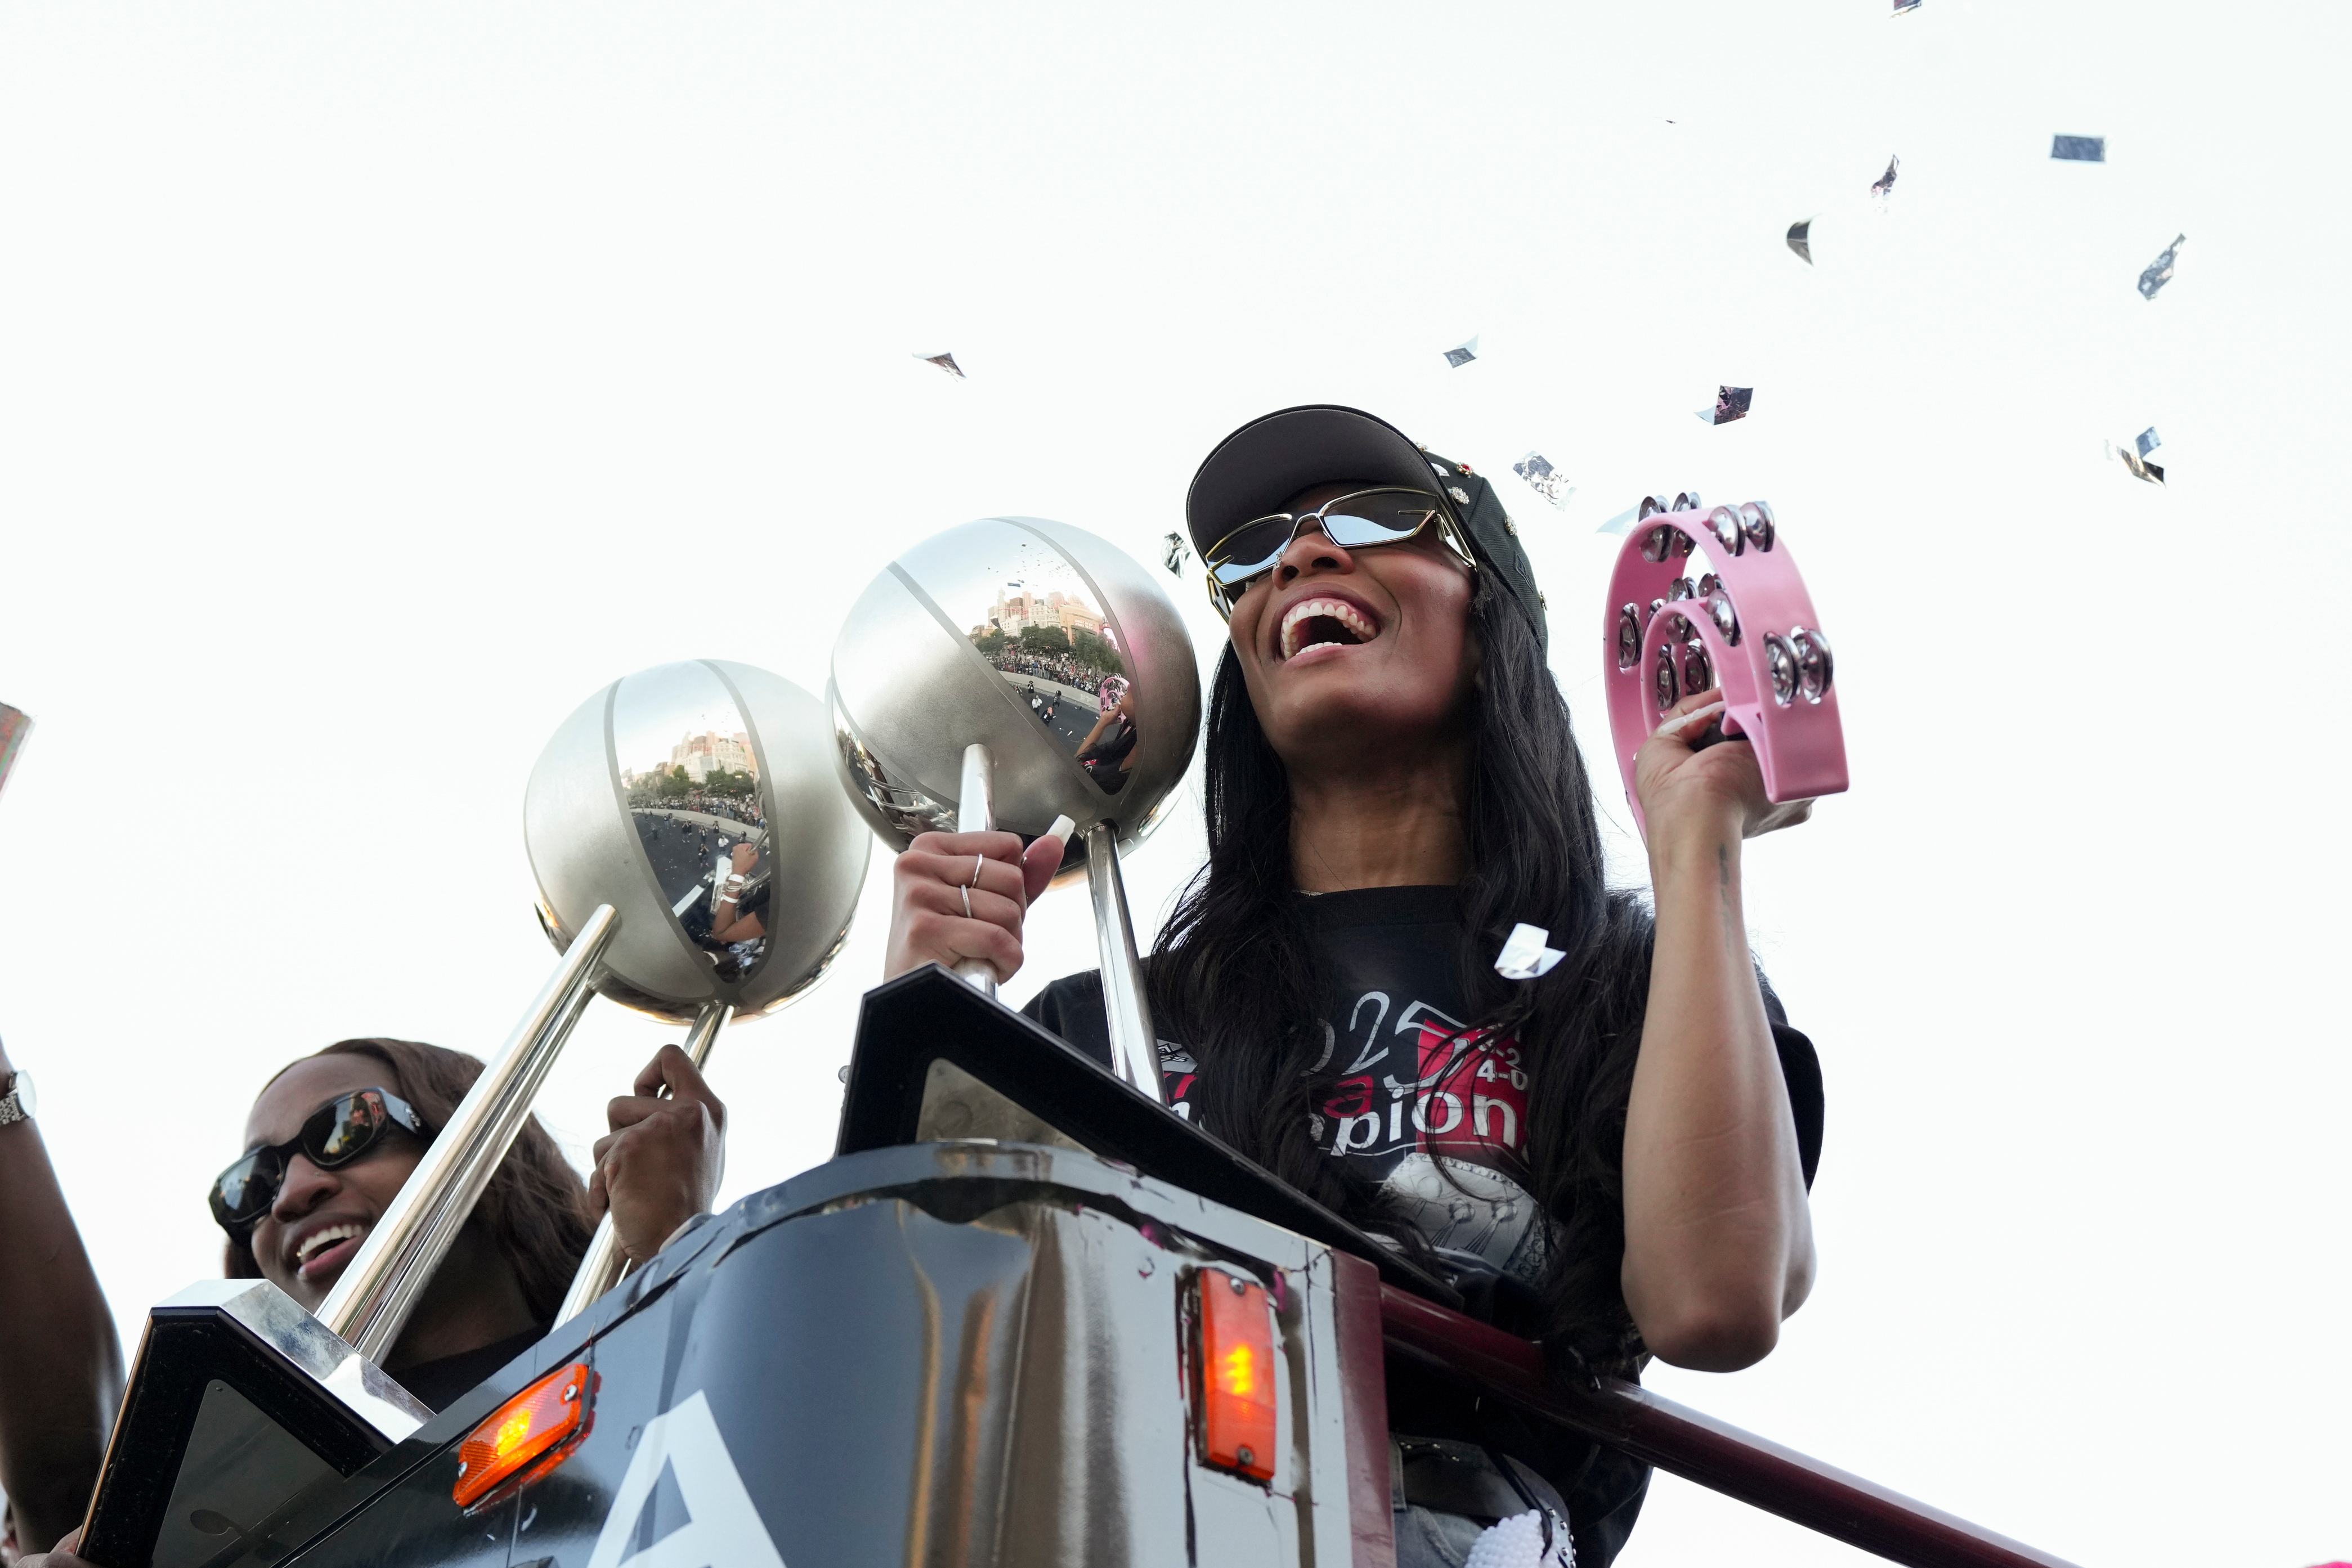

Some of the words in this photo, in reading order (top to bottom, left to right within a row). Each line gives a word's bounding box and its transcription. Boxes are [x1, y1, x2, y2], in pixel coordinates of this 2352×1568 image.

[1476, 1058, 1529, 1091] 4-0
[1309, 1086, 1518, 1157] pion
[586, 1388, 787, 1568] A
